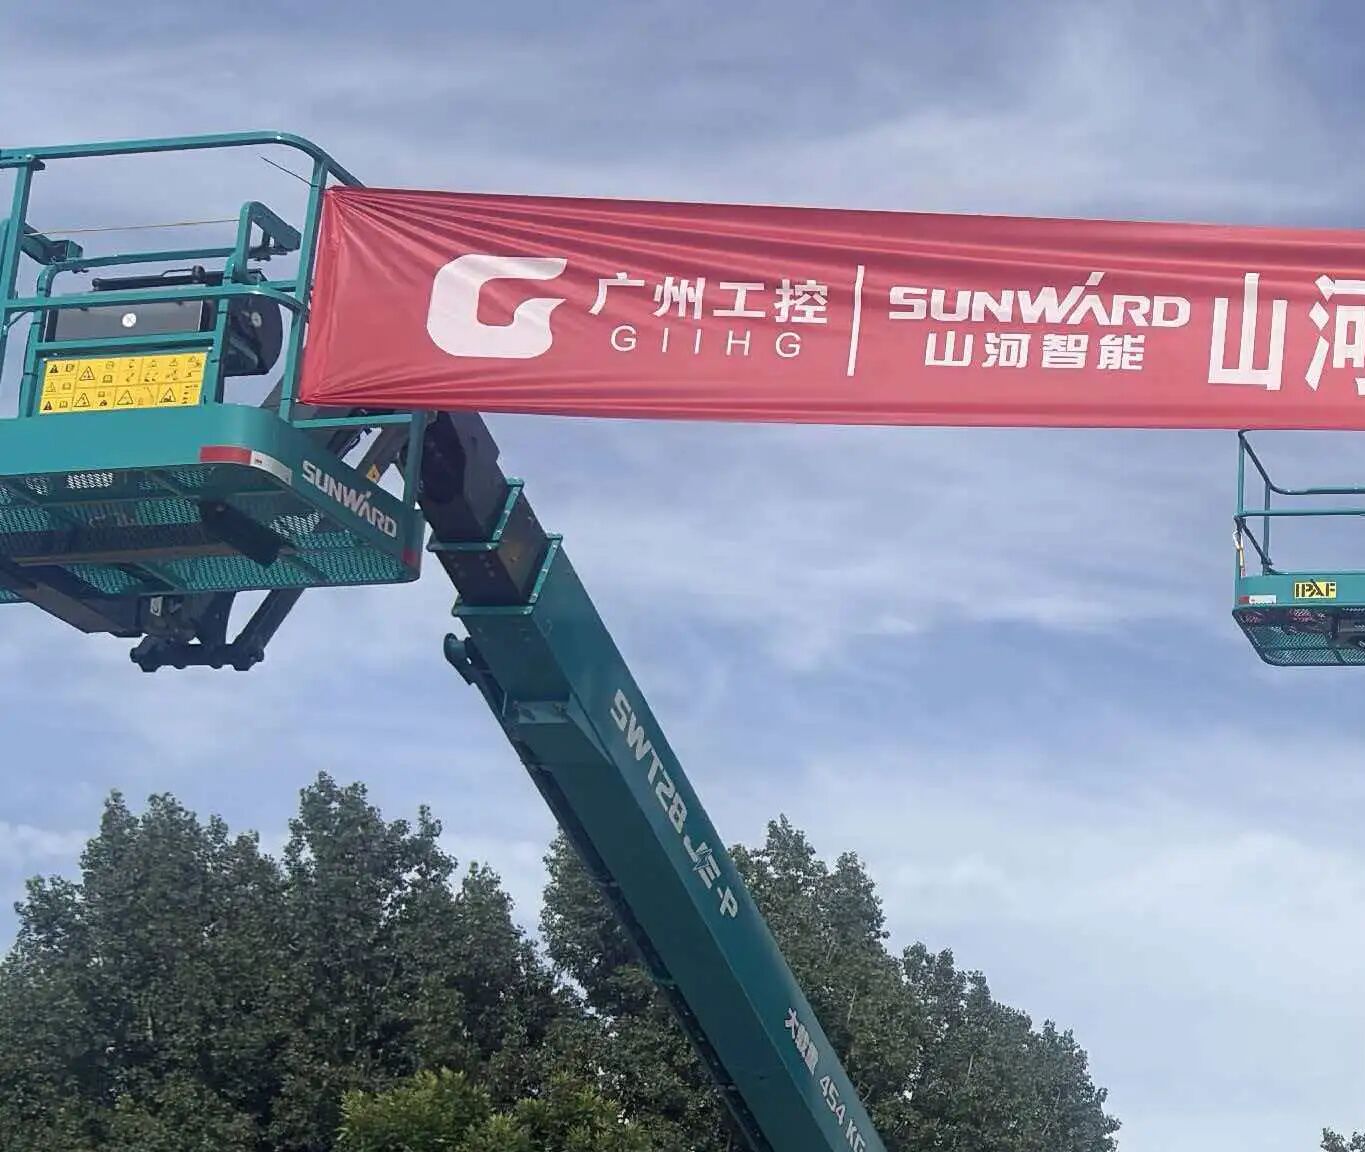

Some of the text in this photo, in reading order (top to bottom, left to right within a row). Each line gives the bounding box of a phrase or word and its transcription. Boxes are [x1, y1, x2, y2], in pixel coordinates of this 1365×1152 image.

[590, 272, 828, 324] 广州工控
[888, 271, 1191, 328] SUNWARD
[610, 325, 802, 358] GIIHG
[924, 330, 1146, 371] 山河智能
[302, 460, 397, 538] SUNWARD
[1295, 579, 1336, 598] IPAF
